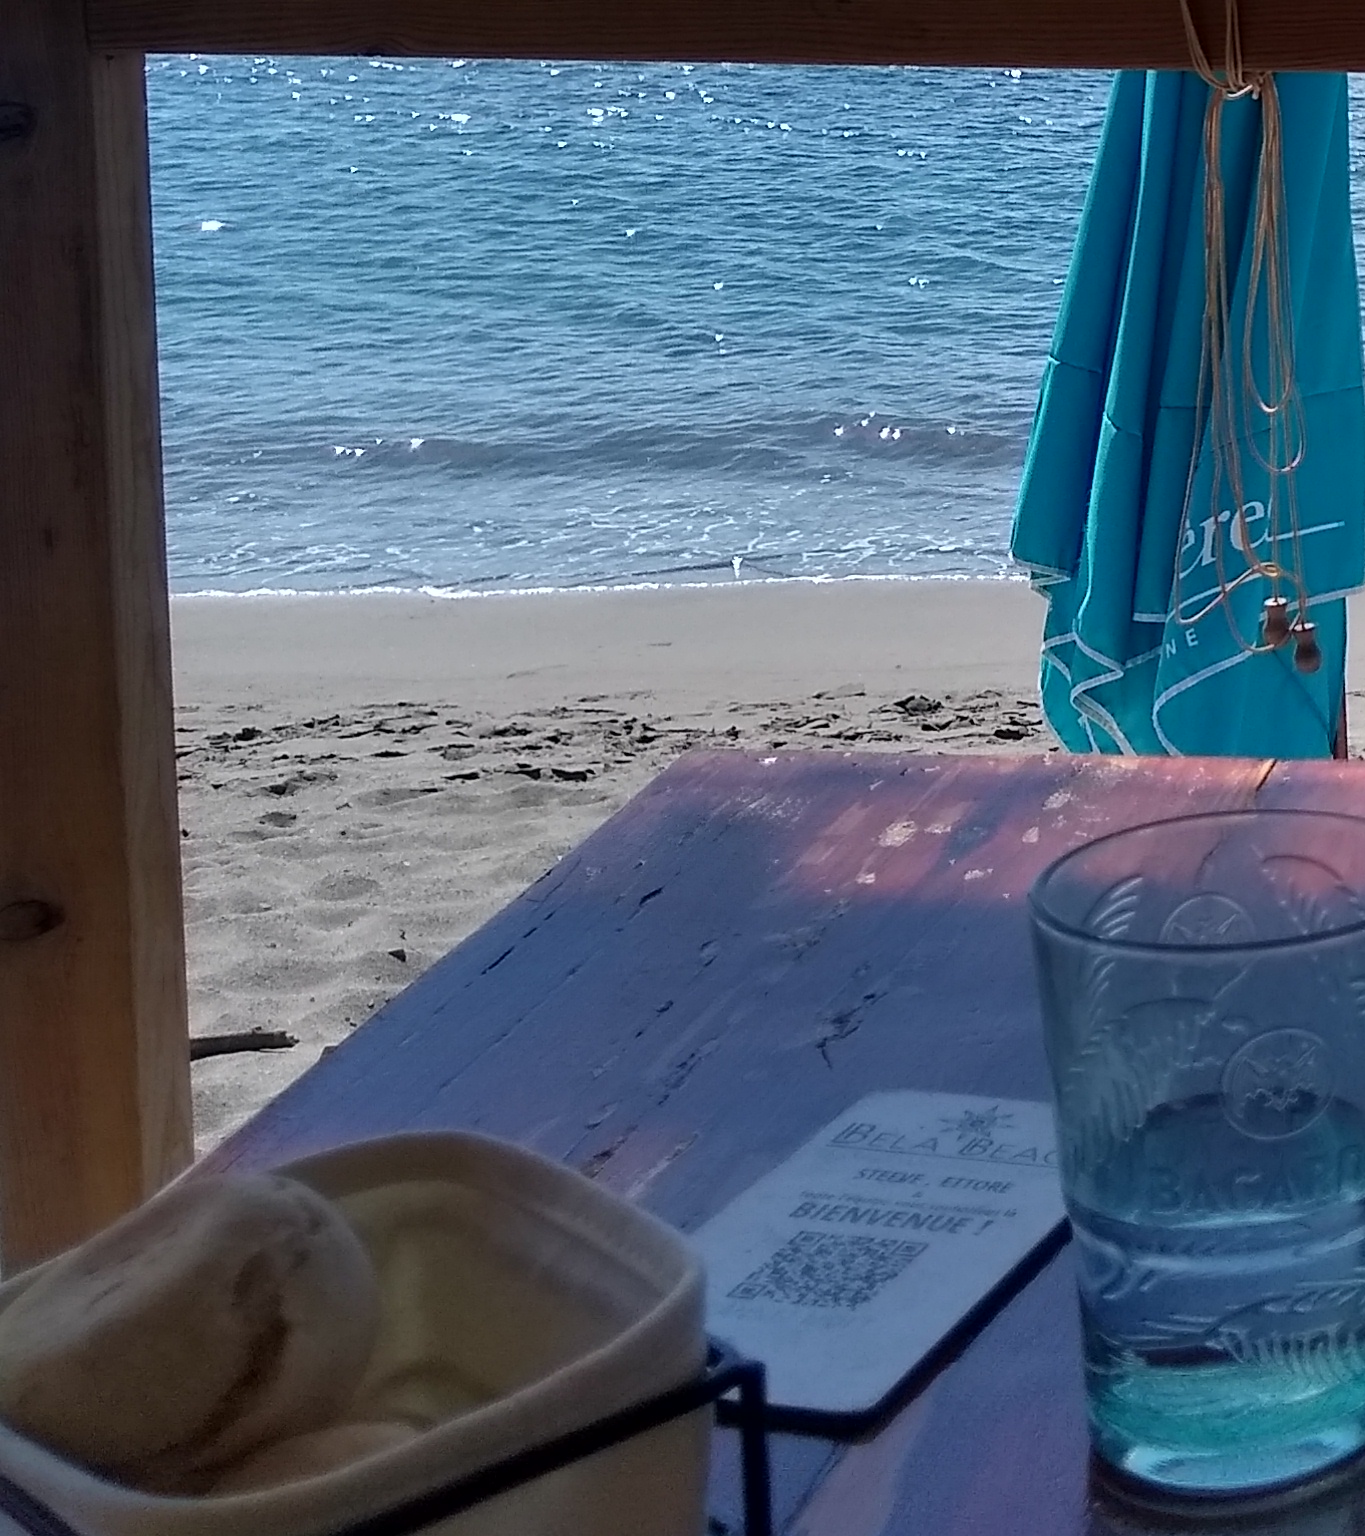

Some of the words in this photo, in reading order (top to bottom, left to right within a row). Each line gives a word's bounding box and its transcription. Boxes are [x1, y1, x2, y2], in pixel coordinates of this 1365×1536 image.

[831, 1122, 939, 1153] BELA
[941, 1176, 1015, 1194] ETTORE
[790, 1202, 974, 1235] BIENVENUE
